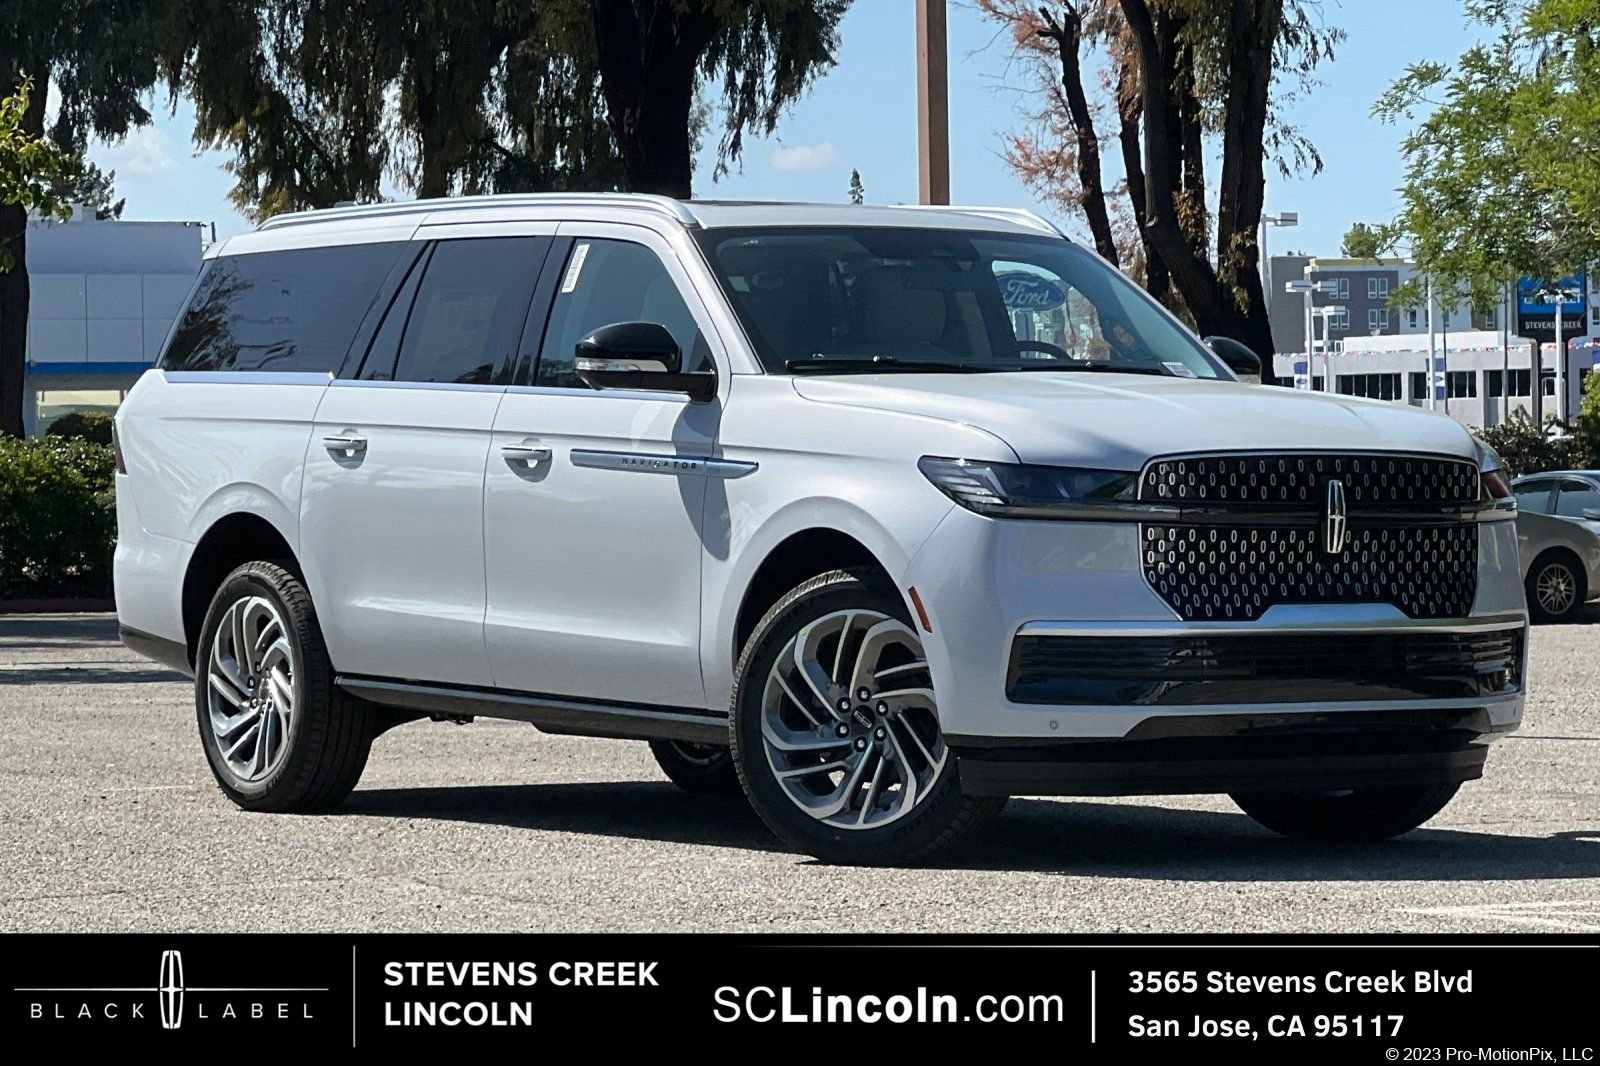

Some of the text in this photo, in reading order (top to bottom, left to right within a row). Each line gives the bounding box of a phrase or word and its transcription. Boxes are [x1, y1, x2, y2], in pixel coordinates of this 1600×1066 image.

[1003, 279, 1050, 305] Ford
[1524, 320, 1582, 330] STEVENS REEK
[621, 457, 697, 470] NAVIGATOR
